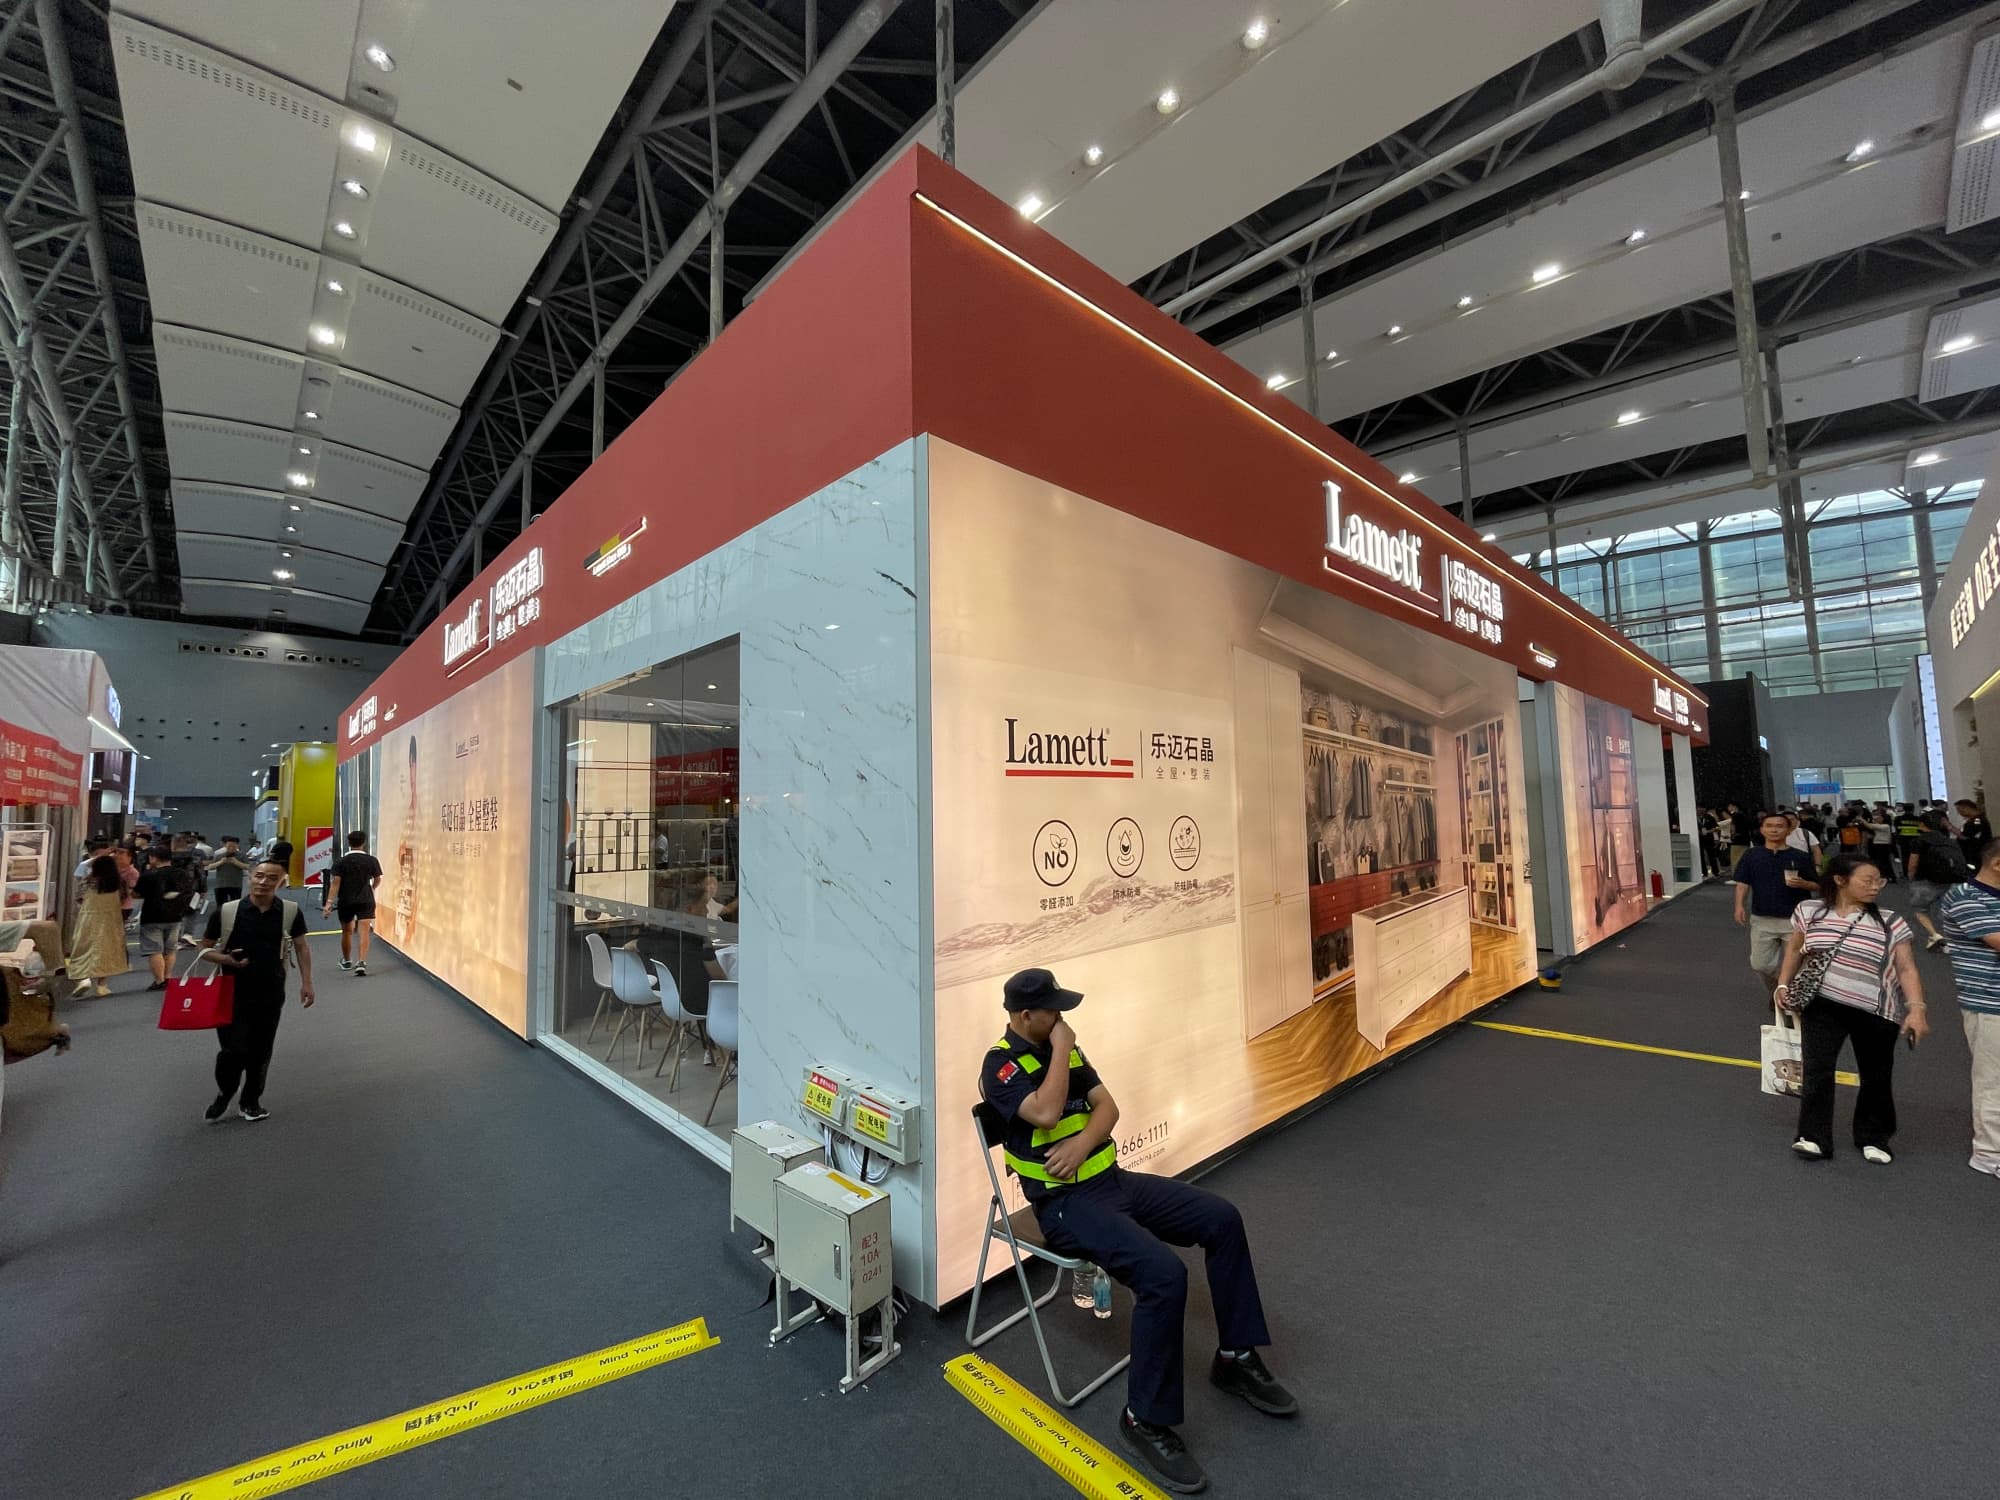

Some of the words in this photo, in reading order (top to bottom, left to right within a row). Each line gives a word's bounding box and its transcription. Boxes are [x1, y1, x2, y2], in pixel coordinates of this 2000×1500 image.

[1004, 718, 1109, 766] Lamett
[1151, 733, 1213, 762] 乐迈石晶
[1044, 850, 1069, 870] NO
[860, 1248, 880, 1267] 10A
[599, 1351, 629, 1366] Mind
[634, 1342, 660, 1355] Your
[665, 1331, 697, 1345] Steps
[507, 1369, 574, 1396] 小心绊倒
[1020, 1407, 1047, 1429] Steps
[334, 1435, 373, 1455] Mind
[1046, 1428, 1070, 1448] Your
[289, 1451, 326, 1468] Your
[1070, 1446, 1100, 1469] Mind
[233, 1466, 282, 1487] Steps
